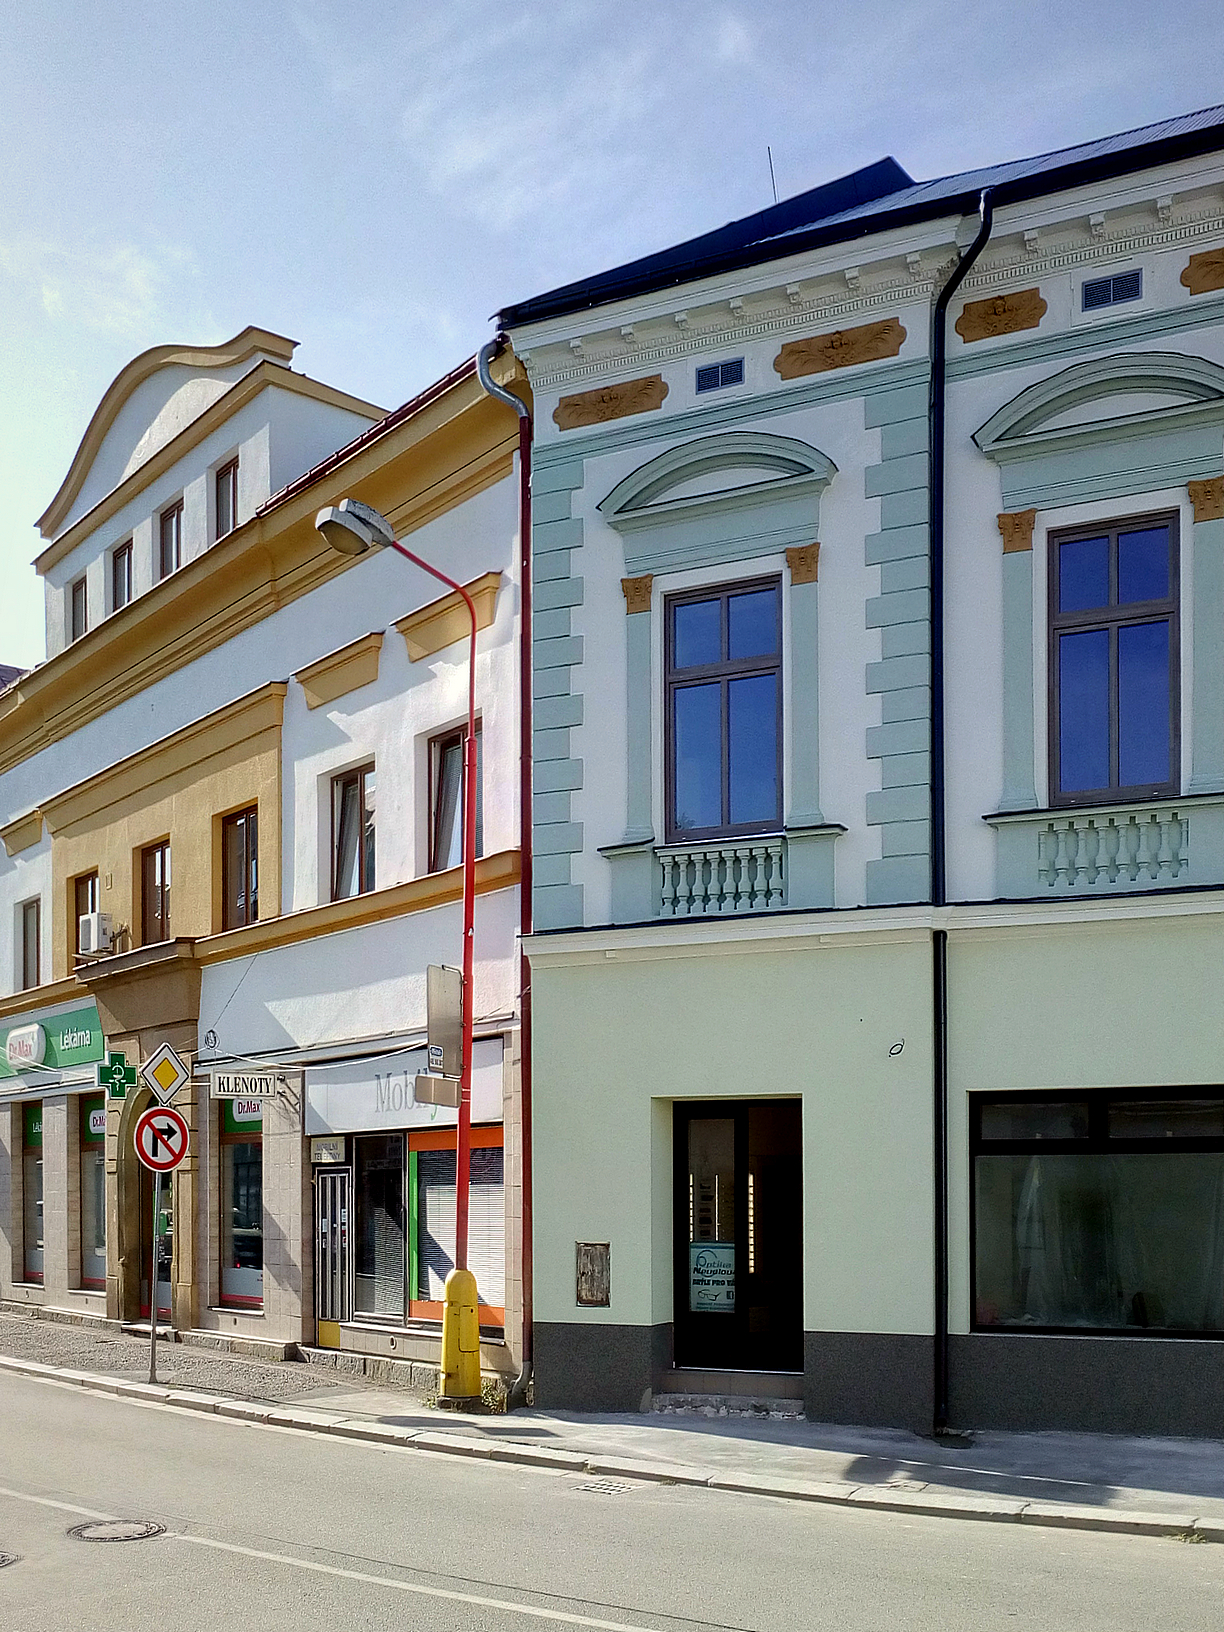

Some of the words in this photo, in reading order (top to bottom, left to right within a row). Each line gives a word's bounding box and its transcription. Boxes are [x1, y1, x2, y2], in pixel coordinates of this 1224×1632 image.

[60, 1027, 91, 1051] Lékárna
[9, 1039, 33, 1060] Dr.Max
[218, 1076, 272, 1094] KLENOTY
[237, 1100, 261, 1114] Dr.Max
[696, 1251, 732, 1268] Optika
